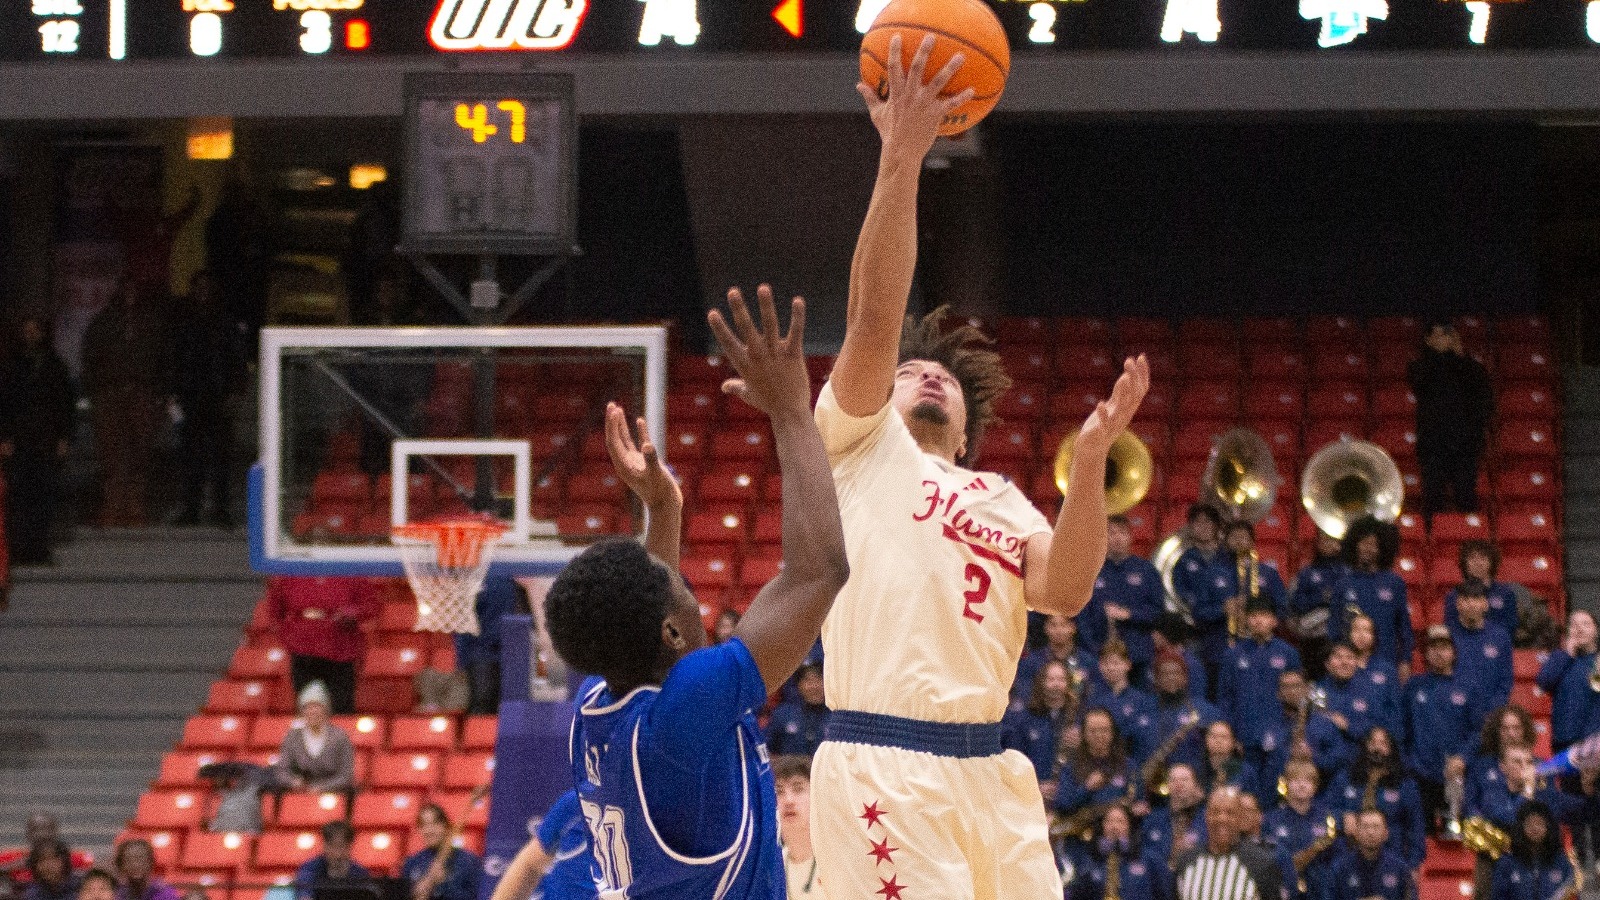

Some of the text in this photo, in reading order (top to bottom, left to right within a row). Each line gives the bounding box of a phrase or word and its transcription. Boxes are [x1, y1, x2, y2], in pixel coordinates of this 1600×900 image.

[38, 20, 80, 53] 12
[299, 10, 333, 54] 3
[428, 0, 588, 52] UIC
[1029, 2, 1057, 44] 2
[453, 98, 528, 145] 47
[963, 563, 992, 623] 2
